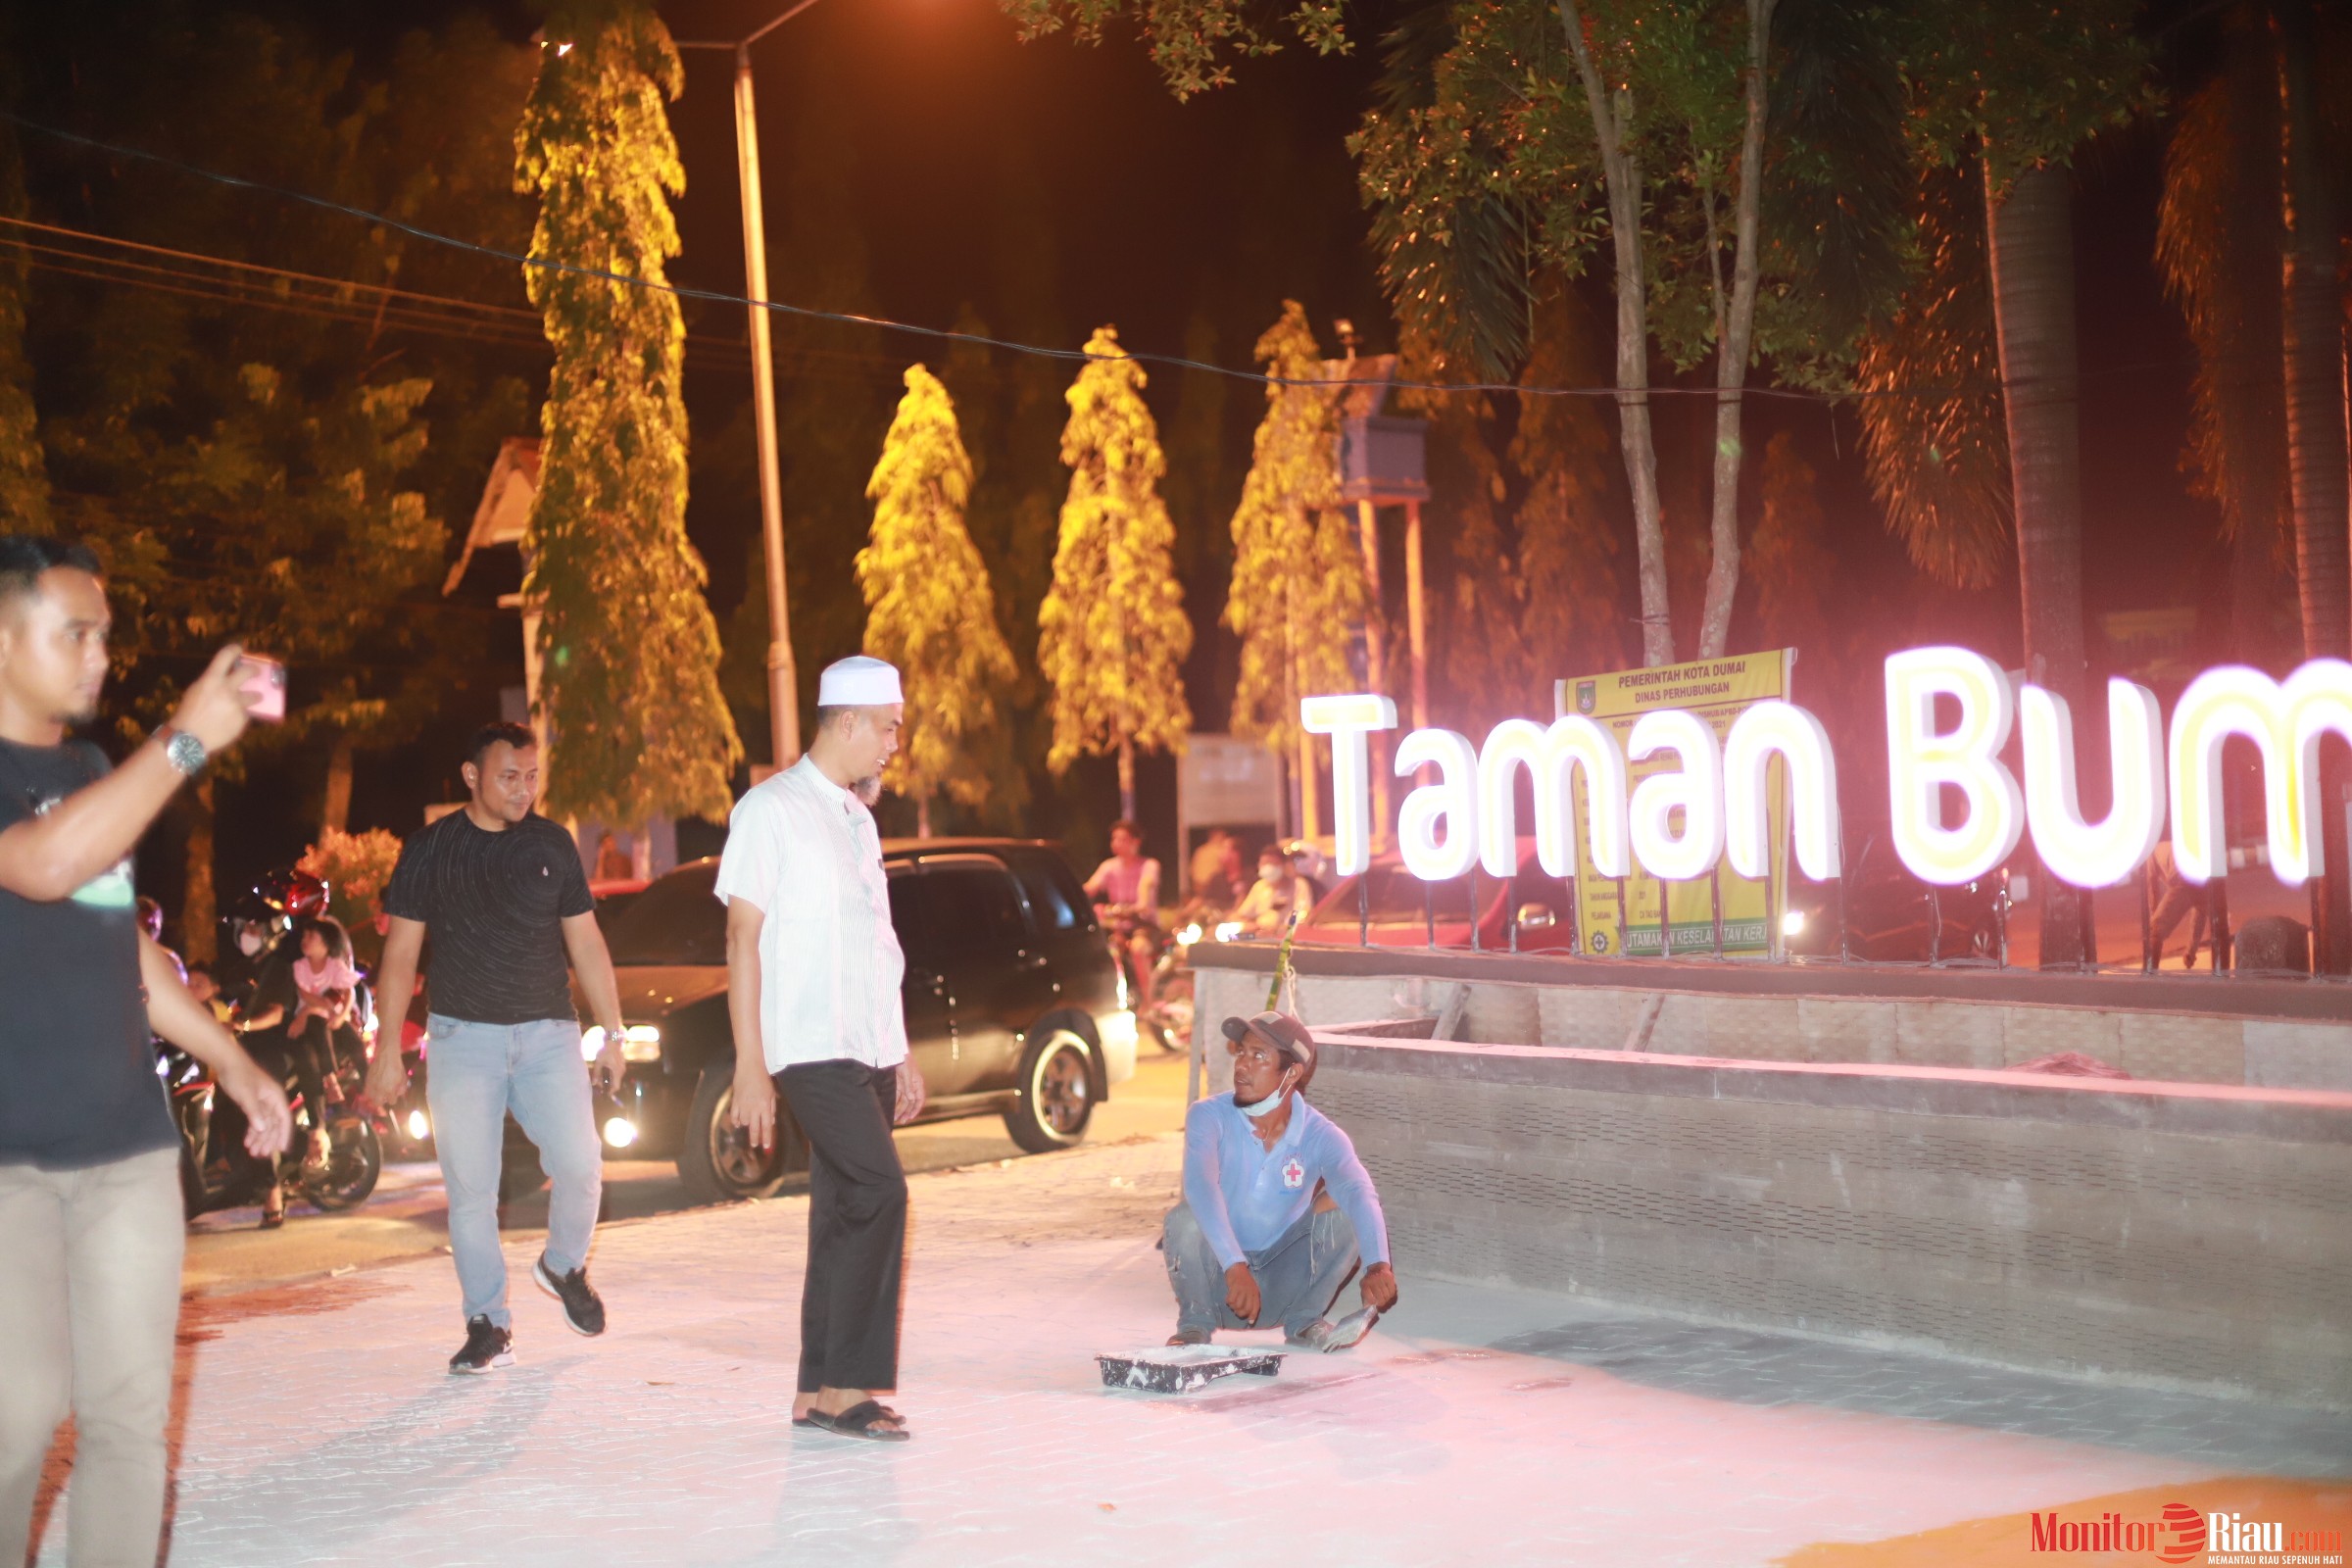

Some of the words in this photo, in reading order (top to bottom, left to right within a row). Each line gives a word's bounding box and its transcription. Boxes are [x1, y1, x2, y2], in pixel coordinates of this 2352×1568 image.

[1618, 670, 1681, 689] PEMERINTAH
[1683, 665, 1711, 680] KOTA
[1712, 661, 1746, 676] DUMAI
[1635, 687, 1661, 704] DINAS
[1663, 681, 1730, 700] PERHUBUNGAN
[1299, 693, 1840, 882] Taman
[1742, 923, 1768, 942] KERJ
